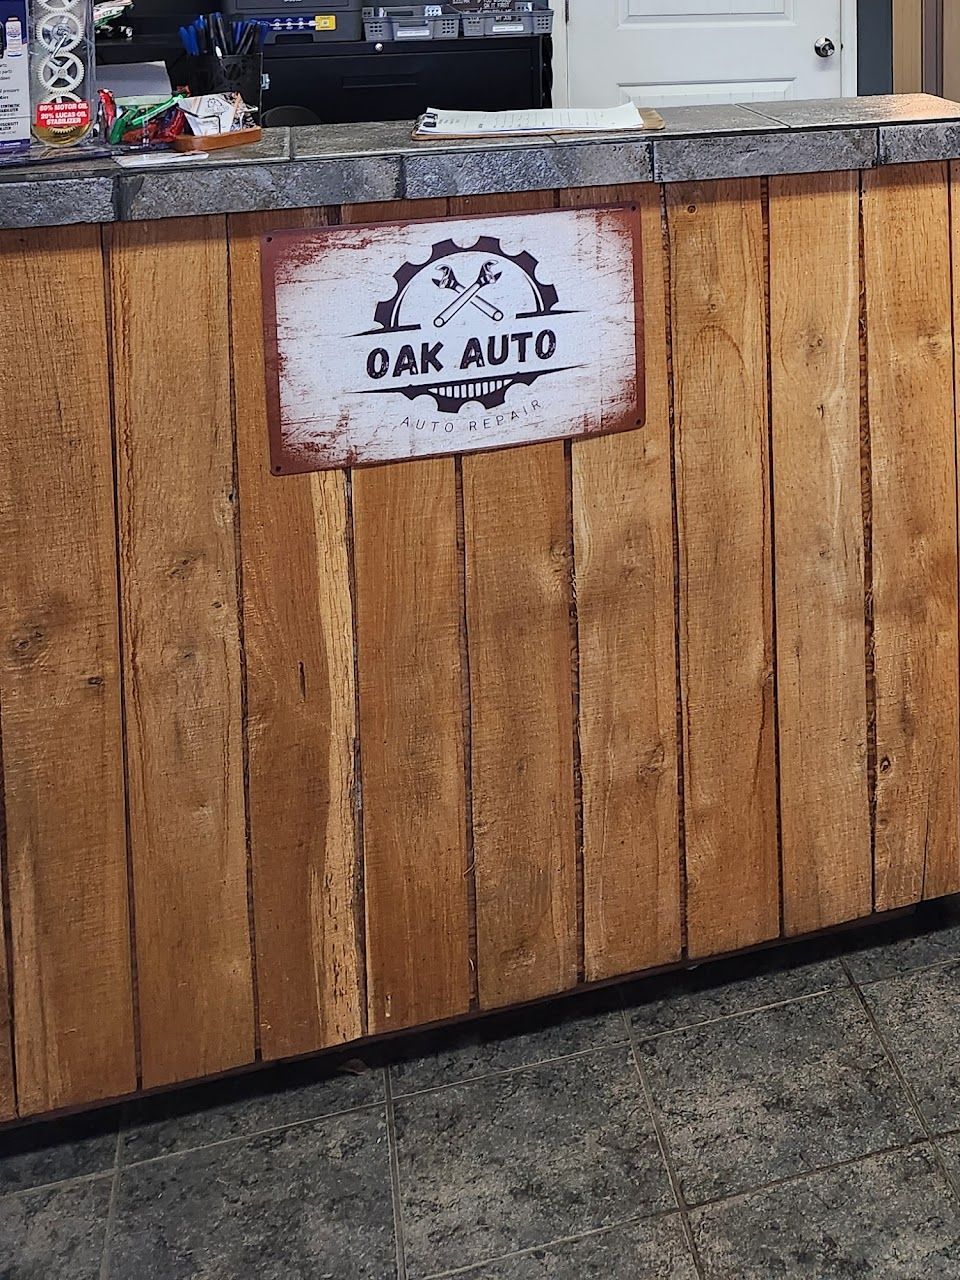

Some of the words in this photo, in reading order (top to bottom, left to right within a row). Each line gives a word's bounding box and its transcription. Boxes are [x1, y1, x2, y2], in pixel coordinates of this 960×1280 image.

[54, 103, 77, 111] MOTOR
[366, 341, 444, 379] OAK
[459, 329, 557, 370] AUTO
[400, 416, 454, 433] AUTO
[469, 399, 541, 431] REPAIR
